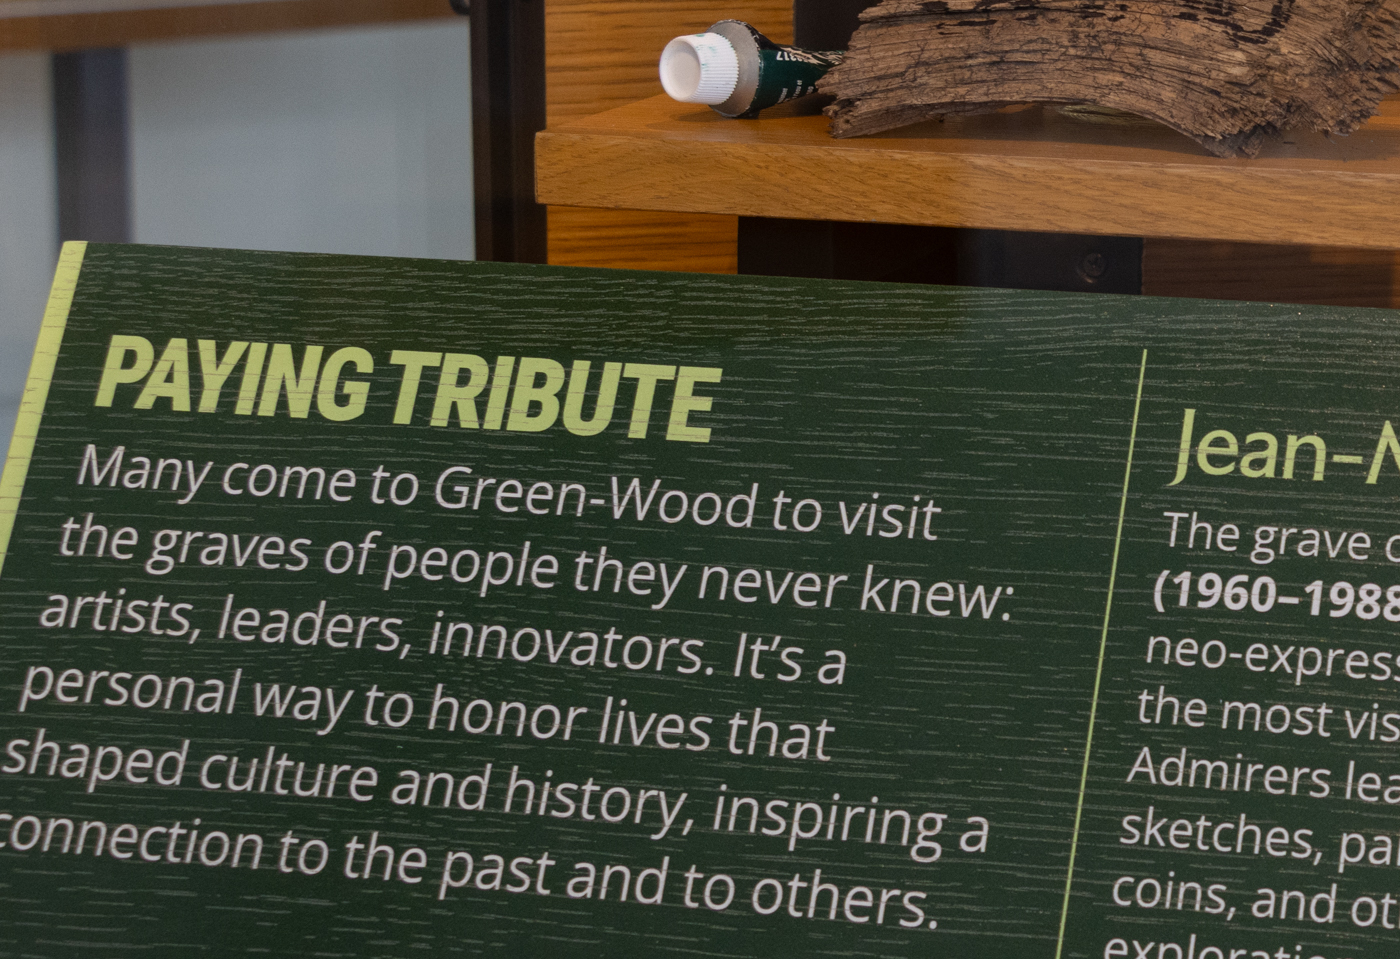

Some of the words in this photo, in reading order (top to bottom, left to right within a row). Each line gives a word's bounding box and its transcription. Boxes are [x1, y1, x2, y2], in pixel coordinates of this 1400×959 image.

[94, 334, 376, 424] PAYING
[388, 348, 723, 443] TRIBUTE
[77, 444, 213, 506] Many
[221, 462, 357, 503] come
[370, 465, 420, 507] to
[434, 465, 760, 529] Green-Wood
[772, 490, 823, 533] to
[838, 492, 942, 542] visit
[1163, 511, 1241, 553] The
[1249, 525, 1372, 566] grave
[59, 513, 139, 561] the
[144, 529, 312, 576] graves
[323, 530, 385, 578] of
[382, 538, 560, 599] people
[574, 546, 688, 611] they
[698, 566, 849, 609] never
[859, 564, 1014, 622] knew:
[39, 588, 200, 645] artists,
[217, 593, 411, 660] leaders,
[428, 610, 714, 677] innovators.
[733, 632, 804, 683] It's
[816, 649, 847, 686] a
[18, 666, 243, 715] personal
[254, 683, 354, 737] way
[364, 685, 415, 729] to
[427, 683, 588, 741] honor
[598, 696, 713, 752] lives
[728, 707, 836, 762] that
[1138, 685, 1208, 729] the
[1220, 701, 1333, 739] most
[2, 728, 191, 794] shaped
[200, 746, 379, 803] culture
[390, 763, 493, 811] and
[503, 765, 694, 841] history,
[712, 784, 947, 864] inspiring
[958, 816, 990, 854] a
[1126, 746, 1331, 799] Admirers
[278, 832, 330, 876] to
[344, 831, 428, 885] the
[438, 851, 555, 901] past
[565, 856, 670, 905] and
[683, 865, 736, 912] to
[751, 868, 938, 931] others.
[1119, 806, 1323, 866] sketches,
[1111, 871, 1236, 922] coins,
[1250, 883, 1338, 924] and
